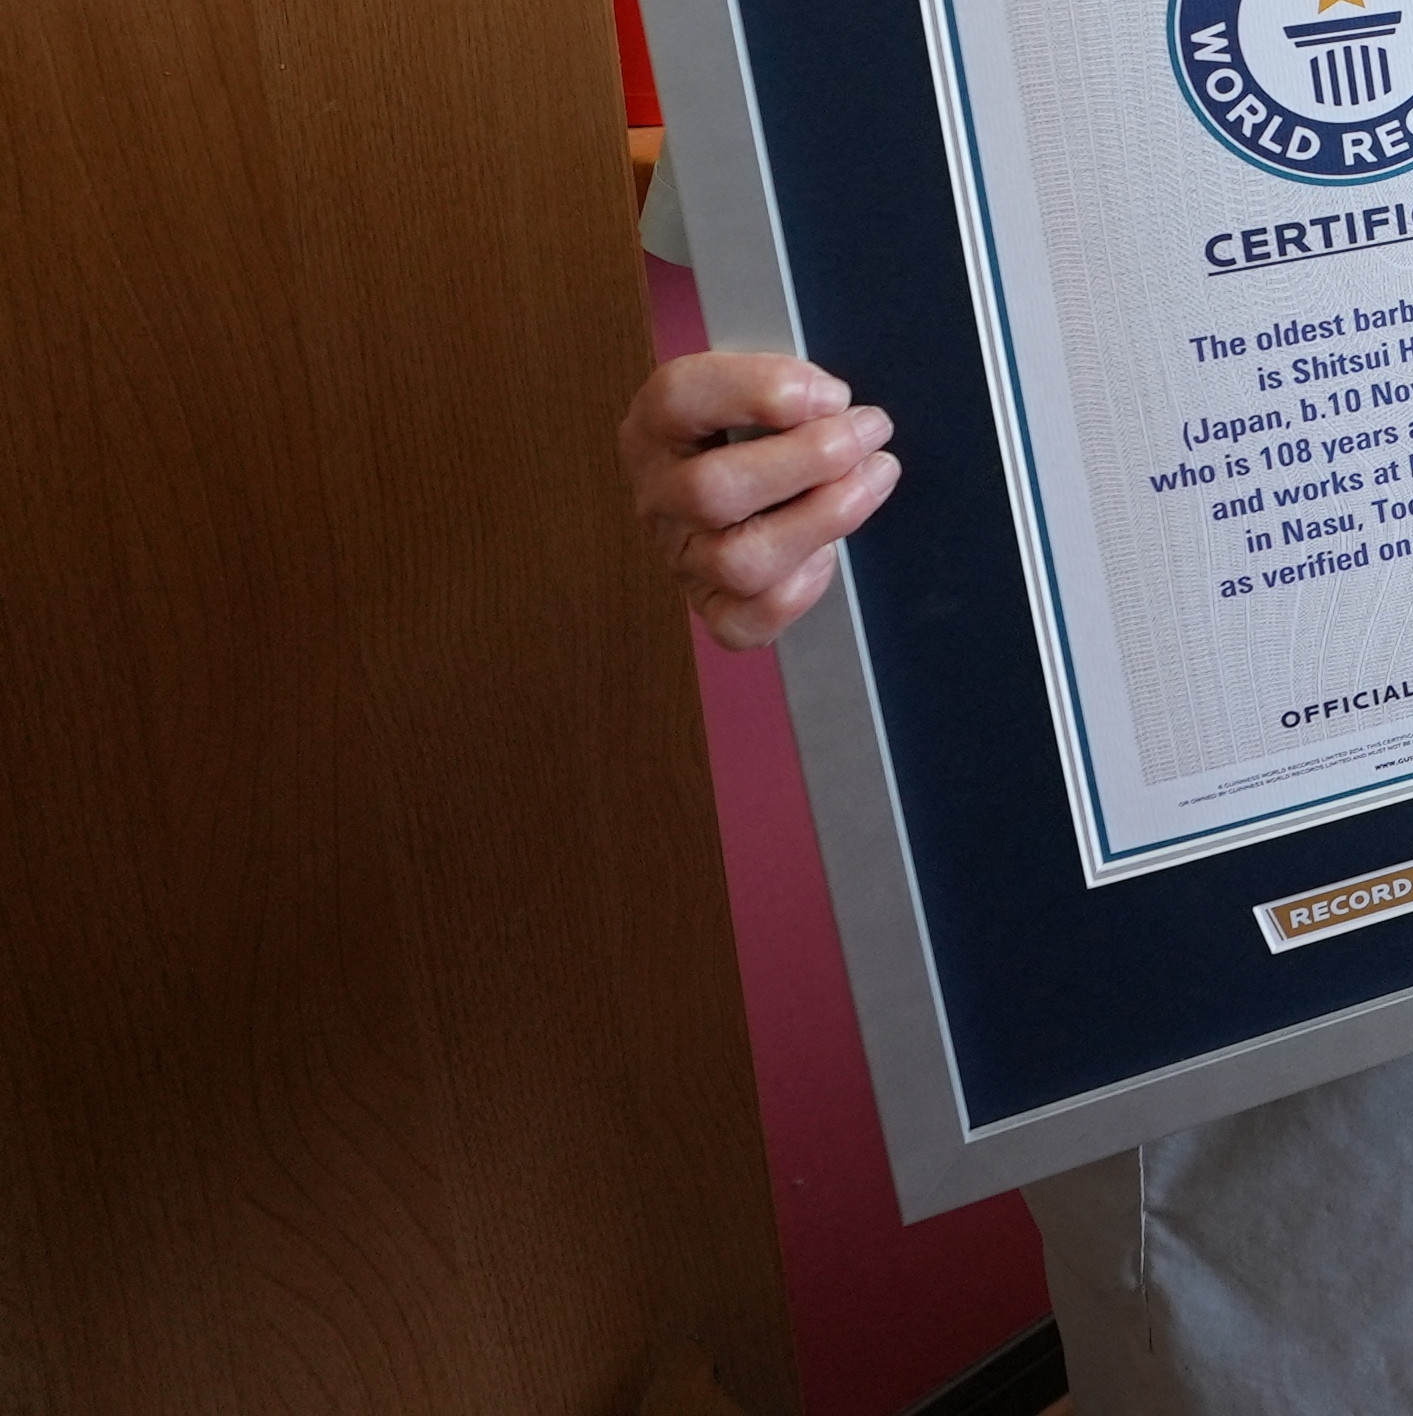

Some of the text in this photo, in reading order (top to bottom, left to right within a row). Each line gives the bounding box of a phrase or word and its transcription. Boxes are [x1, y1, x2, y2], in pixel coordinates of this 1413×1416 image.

[1190, 21, 1321, 161] WORLD
[1188, 334, 1247, 363] The
[1256, 314, 1346, 351] oldest
[1256, 366, 1283, 392] is
[1291, 342, 1390, 385] Shitsui
[1182, 410, 1292, 452] (Japan,
[1299, 388, 1362, 423] b.10
[1148, 462, 1216, 493] who
[1224, 453, 1251, 479] is
[1259, 438, 1313, 471] 108
[1320, 426, 1399, 464] years
[1211, 487, 1265, 521] and
[1272, 470, 1364, 507] works
[1373, 460, 1402, 486] at
[1245, 528, 1273, 554] in
[1281, 513, 1364, 546] Nasu,
[1219, 575, 1254, 599] as
[1261, 542, 1370, 589] verified
[1378, 538, 1412, 562] on
[1288, 878, 1413, 931] RECORD
